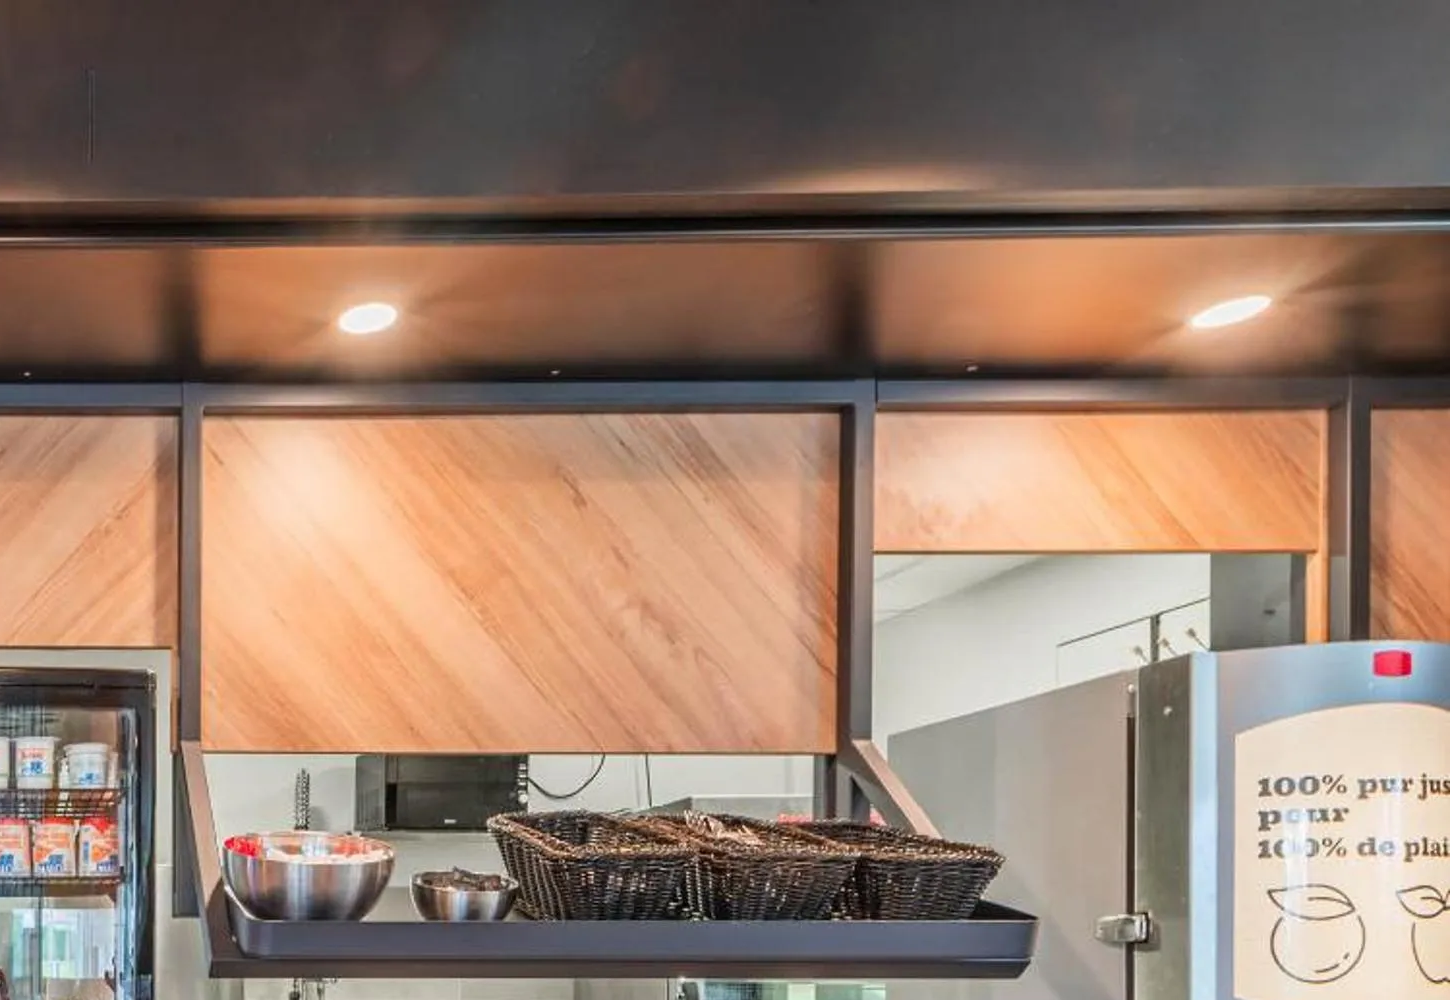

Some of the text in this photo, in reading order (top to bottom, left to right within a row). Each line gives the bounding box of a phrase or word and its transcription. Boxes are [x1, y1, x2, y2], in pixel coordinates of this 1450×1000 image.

[1257, 772, 1450, 801] 100% pur jus
[1257, 807, 1350, 832] pour
[1356, 837, 1396, 857] de
